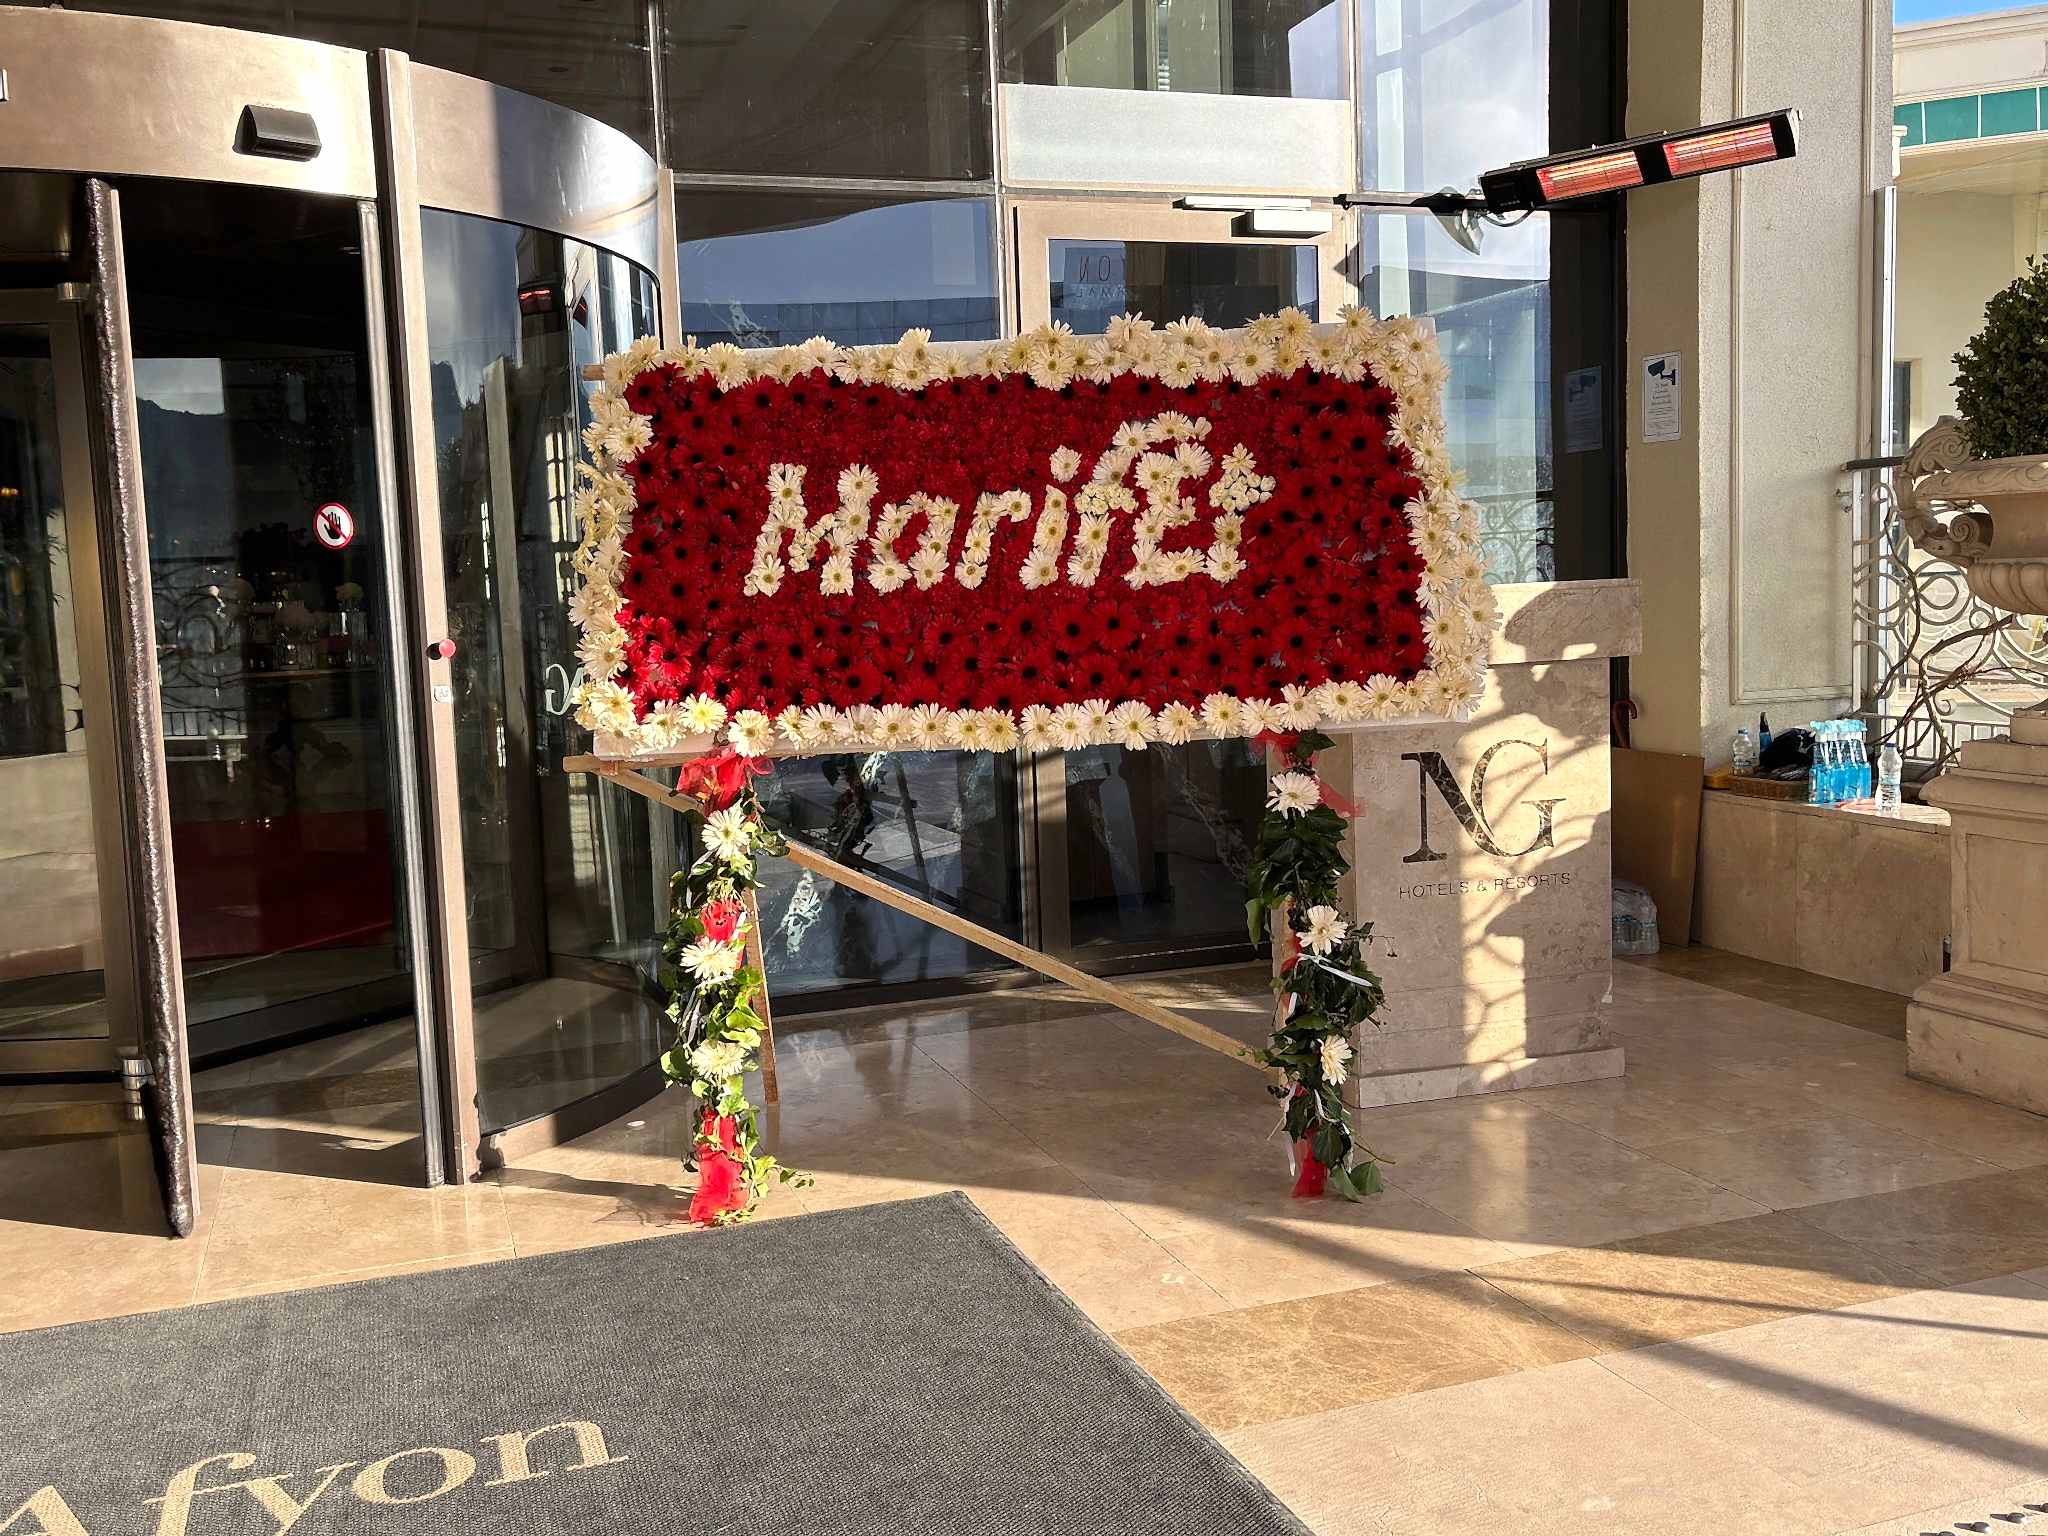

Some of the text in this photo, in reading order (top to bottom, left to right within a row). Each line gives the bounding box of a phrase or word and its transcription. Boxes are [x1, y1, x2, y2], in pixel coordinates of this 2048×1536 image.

[1400, 737, 1567, 864] NG
[1399, 871, 1571, 900] HOTELS & RESORTS
[0, 1419, 630, 1536] Afyon
